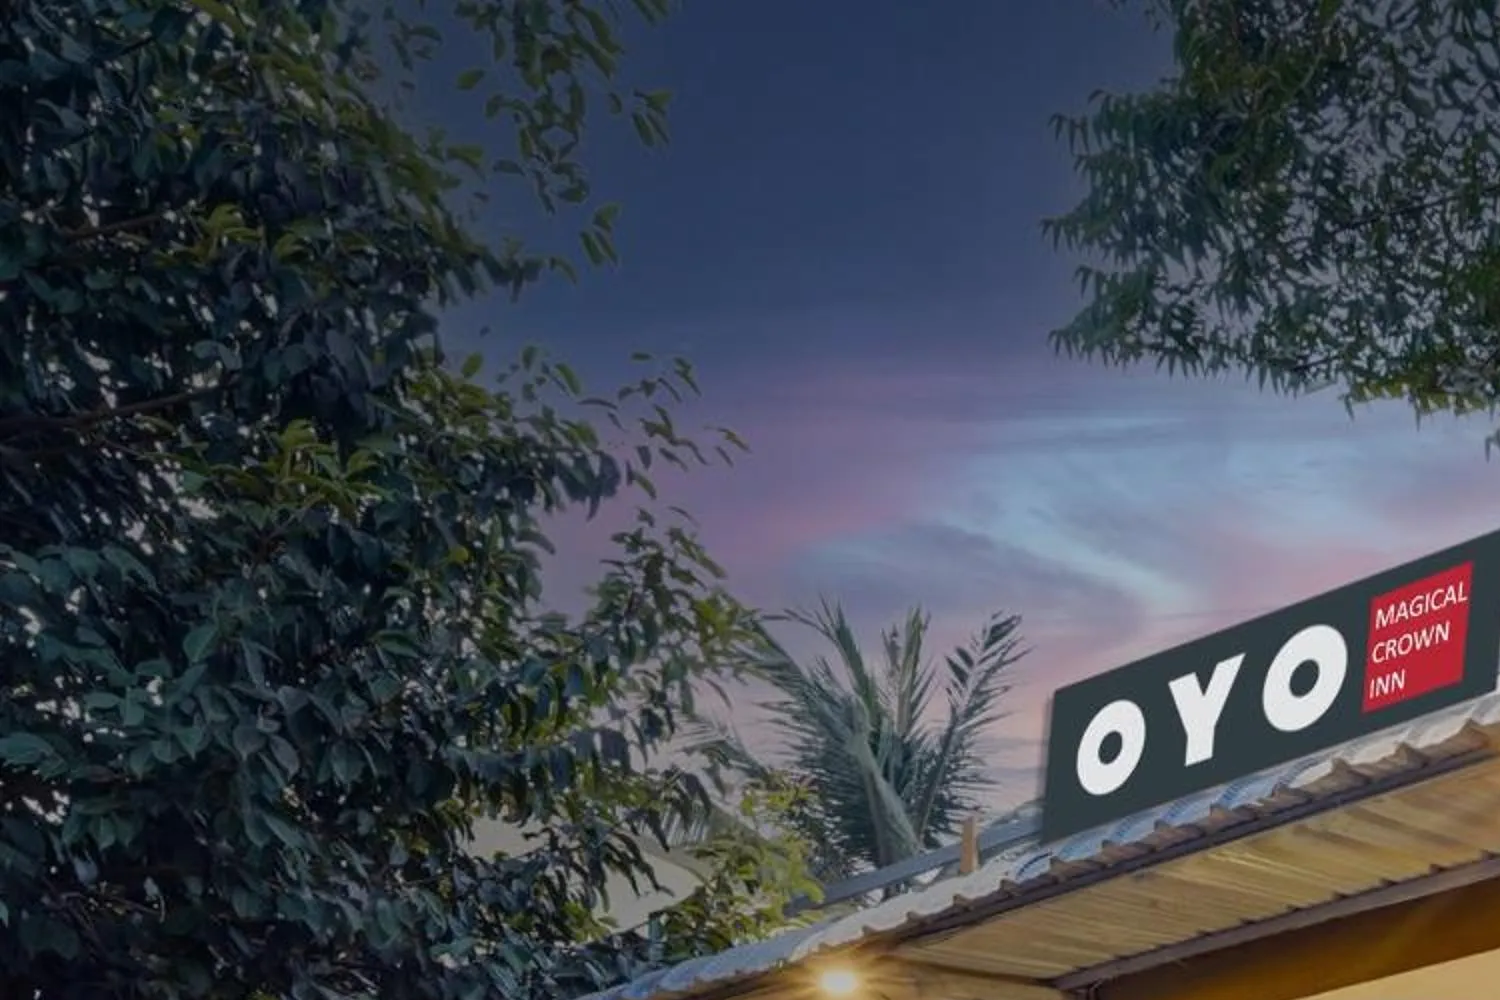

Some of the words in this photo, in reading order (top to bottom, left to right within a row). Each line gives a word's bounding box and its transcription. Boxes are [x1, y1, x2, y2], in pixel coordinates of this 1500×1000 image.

[1375, 581, 1468, 629] MAGICAL
[1371, 621, 1450, 663] CROWN
[1369, 669, 1406, 698] INN
[1076, 625, 1348, 795] OYO
